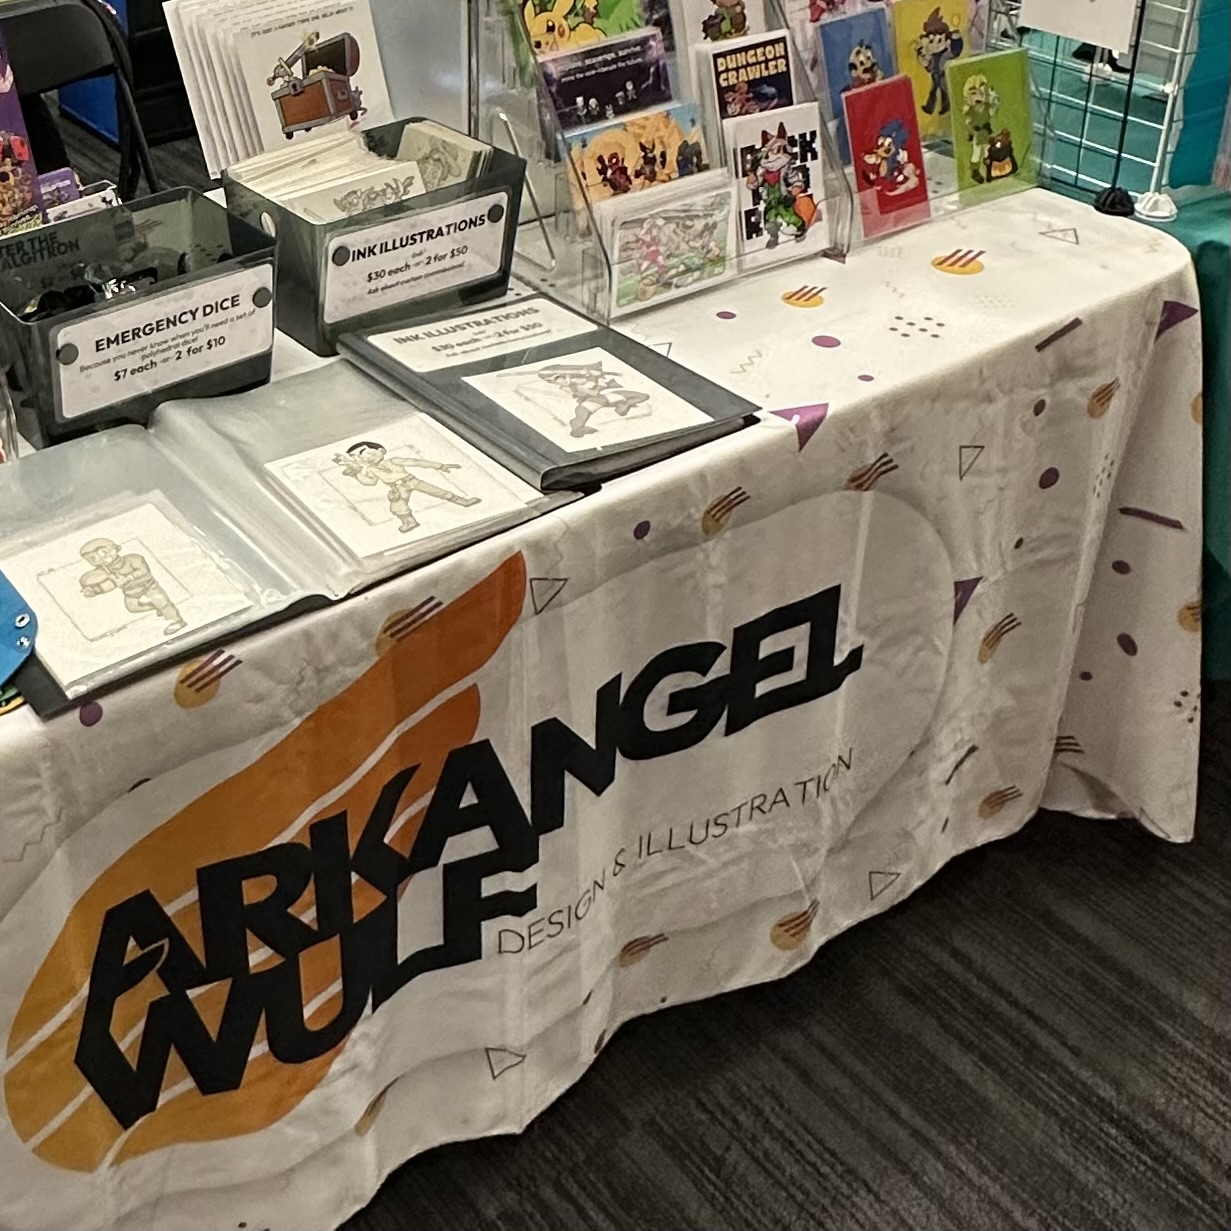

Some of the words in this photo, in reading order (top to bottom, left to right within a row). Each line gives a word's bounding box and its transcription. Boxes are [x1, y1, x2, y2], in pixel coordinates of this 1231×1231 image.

[716, 42, 786, 72] DUNGEON
[719, 57, 788, 88] CRAWLER
[352, 243, 378, 263] INK
[378, 214, 486, 256] ILLUSTRATIONS
[366, 268, 386, 283] $30
[387, 261, 411, 276] each
[425, 255, 432, 266] 2
[433, 252, 449, 264] for
[449, 244, 469, 259] $50
[95, 306, 200, 354] EMERGENCY
[202, 293, 242, 319] DICE
[127, 346, 149, 360] never
[149, 338, 170, 351] know
[170, 330, 191, 343] when
[210, 317, 229, 330] need
[235, 312, 247, 323] set
[247, 308, 256, 319] of
[393, 332, 425, 345] INK
[422, 306, 541, 339] ILLUSTRATIONS
[113, 368, 128, 382] $7
[129, 359, 158, 376] each
[175, 350, 183, 362] 2
[185, 343, 204, 357] for
[206, 335, 226, 351] $10
[78, 583, 865, 993] ARKANGEL
[496, 873, 608, 956] DESIGN
[611, 847, 628, 878] &
[635, 747, 855, 861] ILLUSTRATION
[74, 860, 538, 1131] WULF
